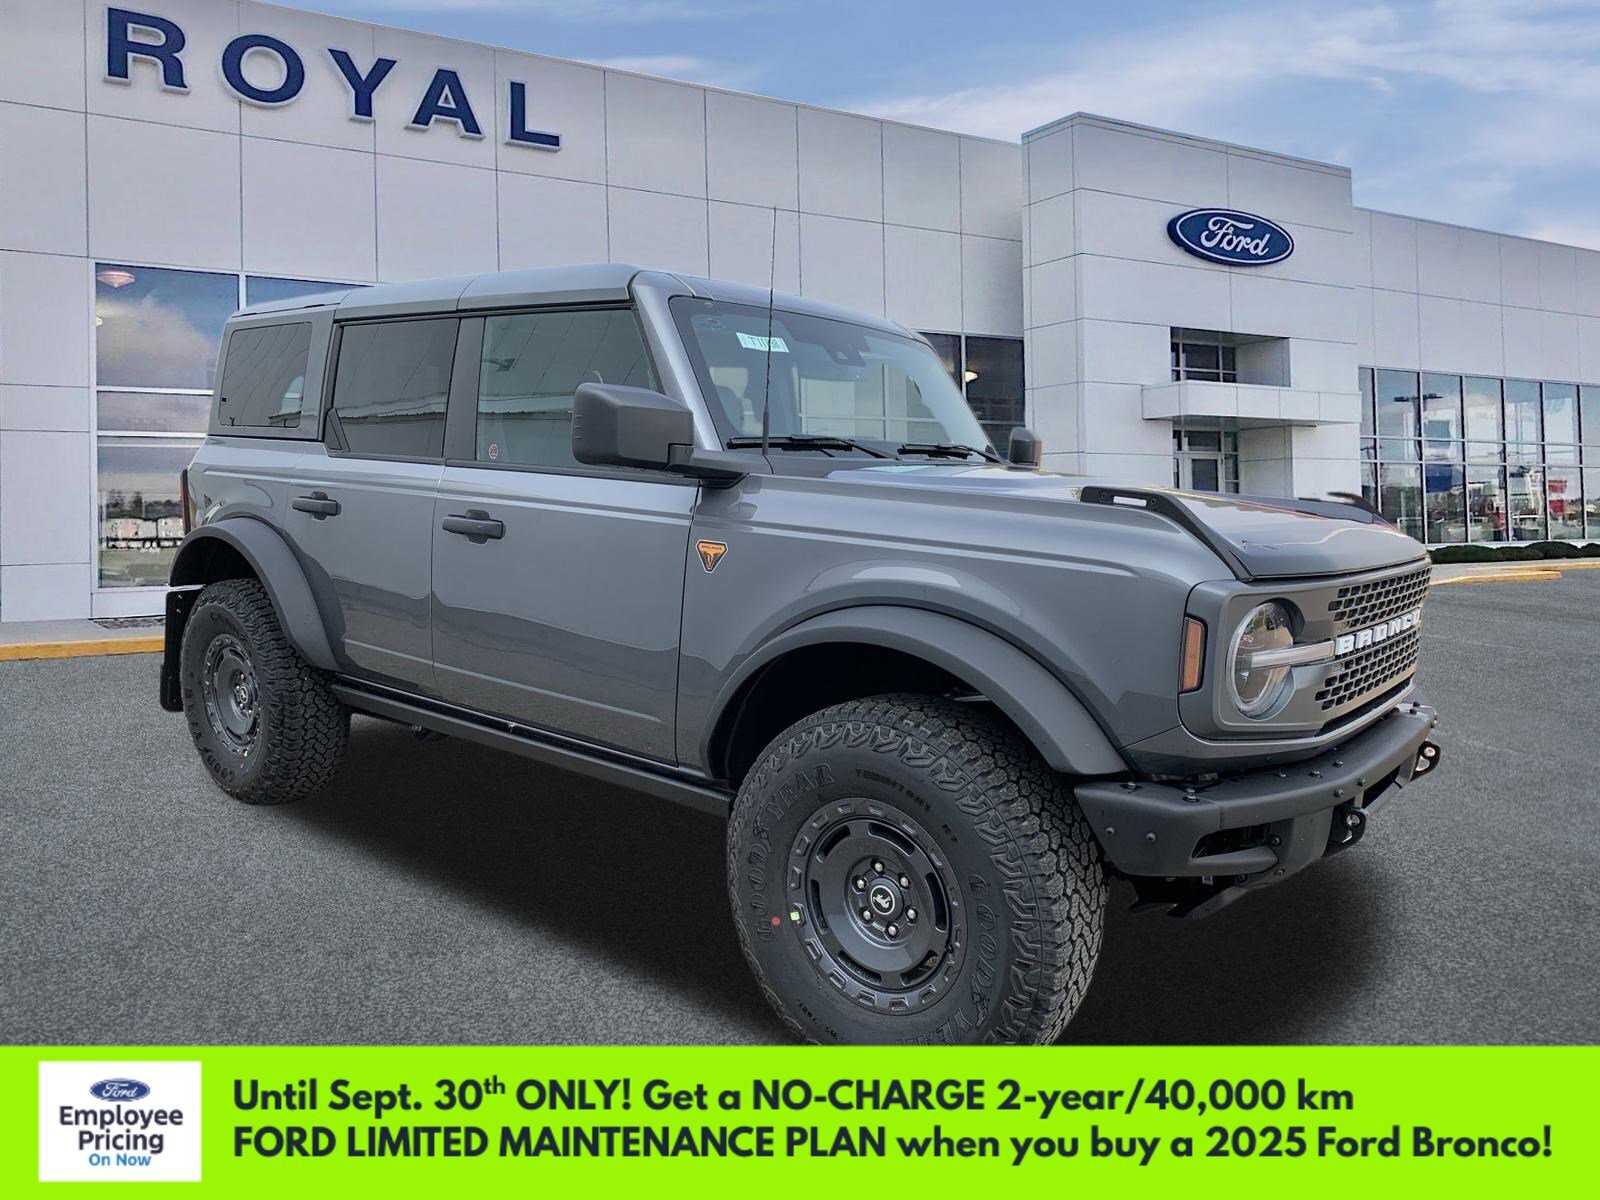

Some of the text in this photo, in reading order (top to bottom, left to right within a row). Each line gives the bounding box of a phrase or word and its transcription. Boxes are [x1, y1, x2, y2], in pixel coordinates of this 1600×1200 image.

[107, 7, 562, 151] ROYAL
[1200, 216, 1271, 256] Ford
[1335, 608, 1421, 656] BRONCO
